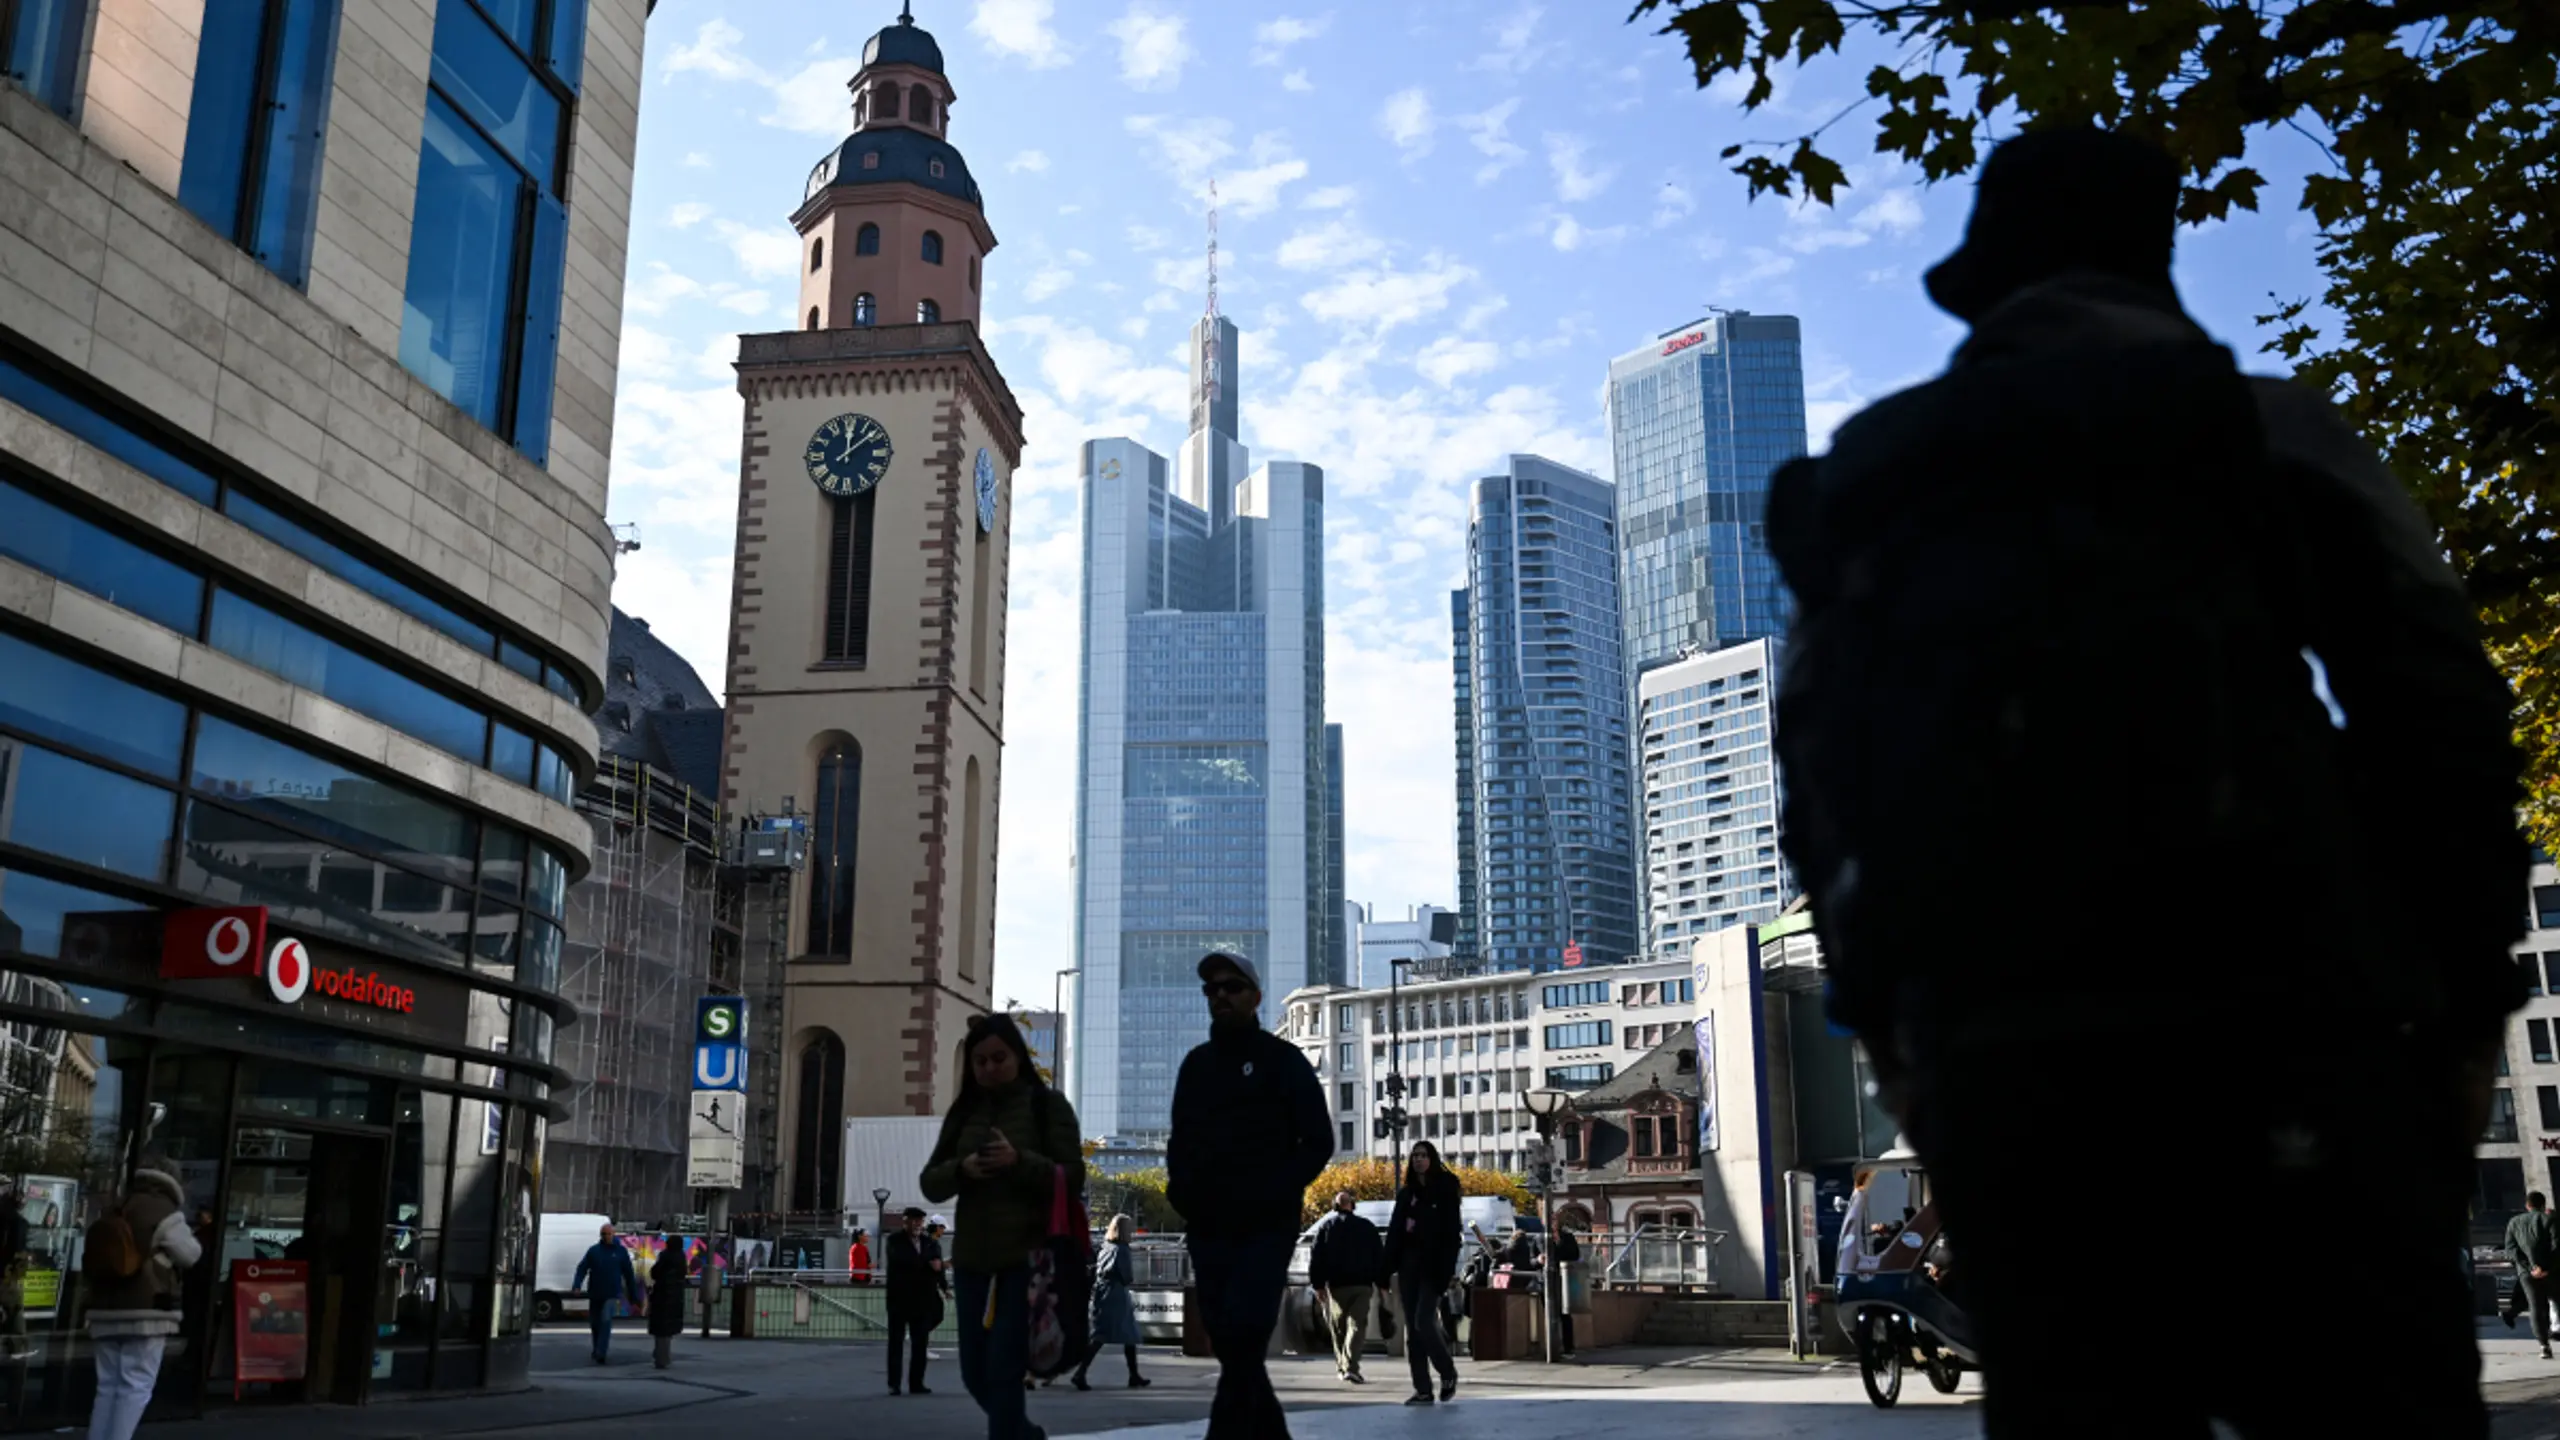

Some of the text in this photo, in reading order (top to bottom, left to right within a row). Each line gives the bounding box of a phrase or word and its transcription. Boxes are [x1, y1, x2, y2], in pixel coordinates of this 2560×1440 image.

[312, 967, 415, 1013] vodafone
[708, 1007, 730, 1035] S
[697, 1047, 736, 1086] U
